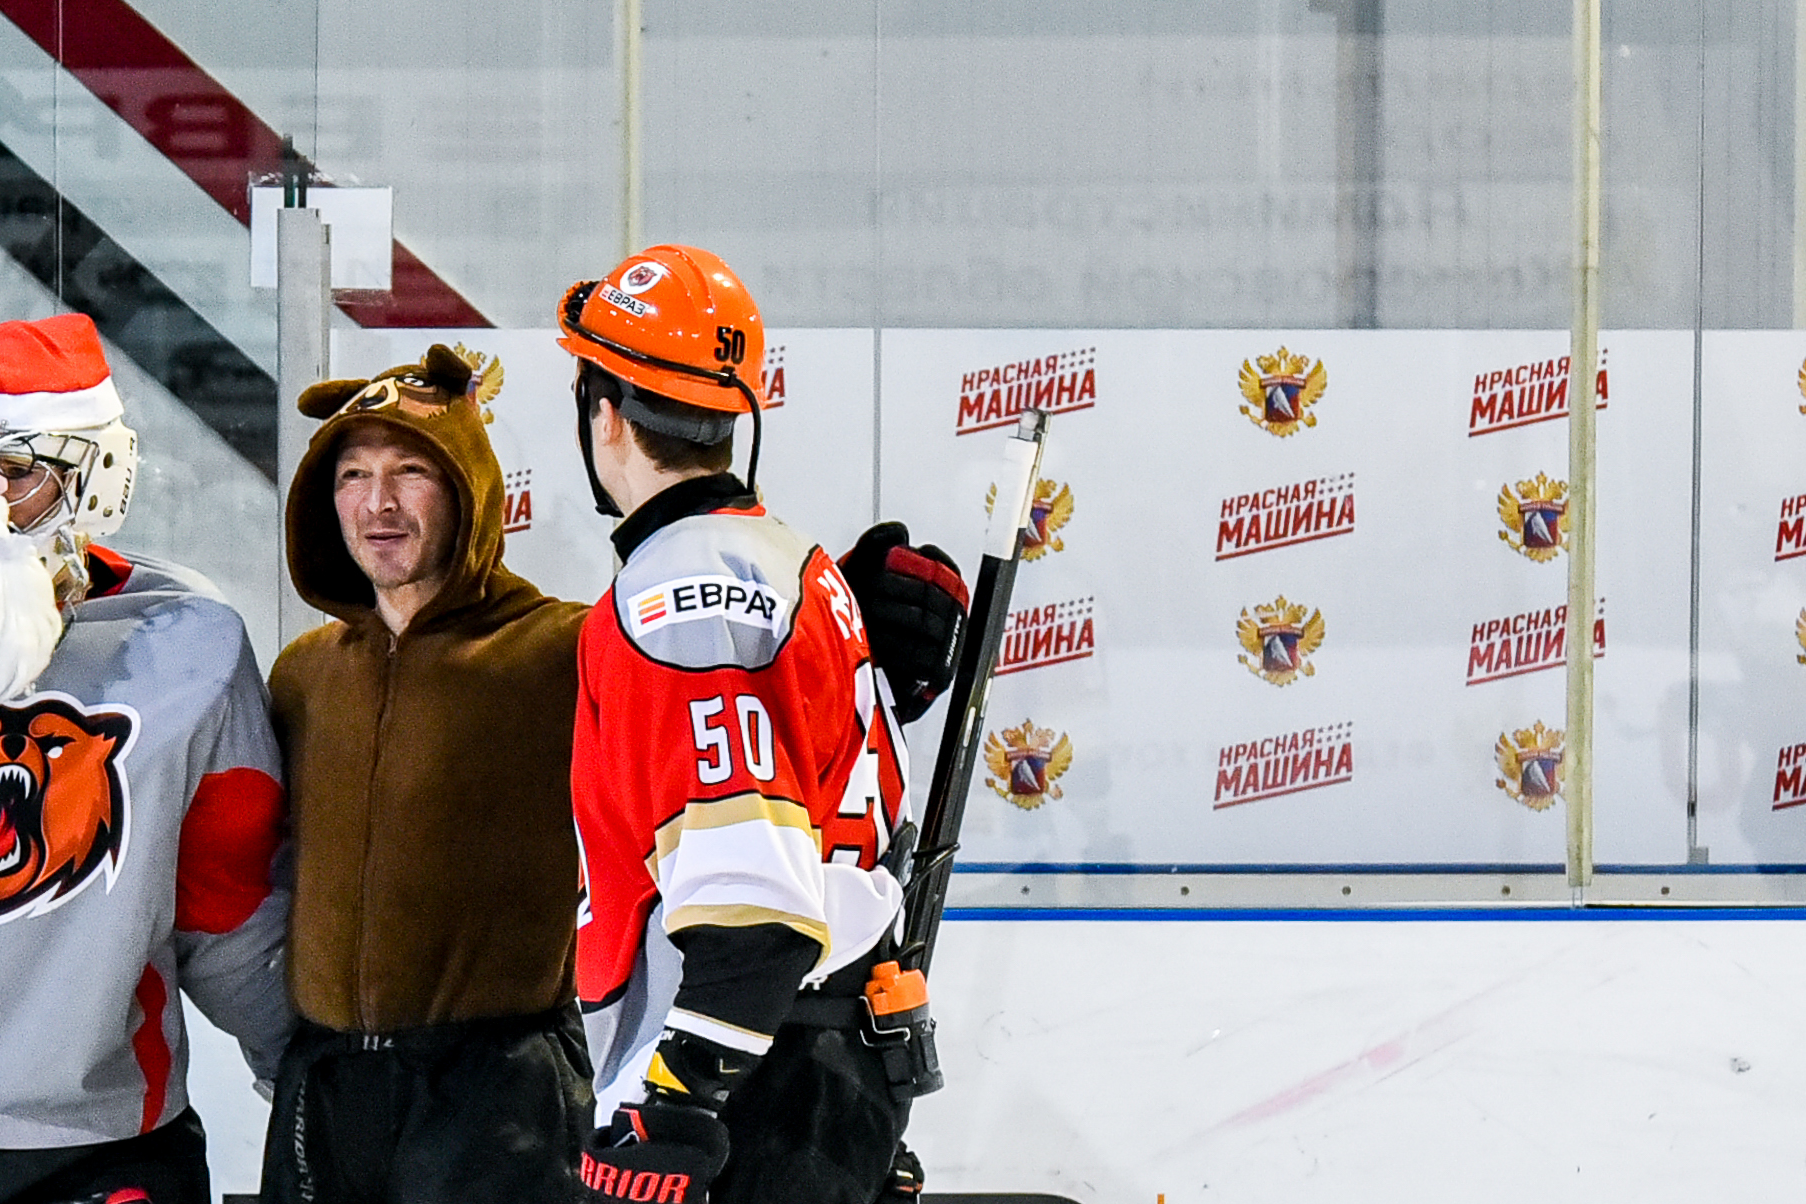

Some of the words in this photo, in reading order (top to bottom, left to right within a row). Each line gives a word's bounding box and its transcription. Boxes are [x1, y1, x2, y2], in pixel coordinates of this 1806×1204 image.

[609, 288, 646, 316] ЕВРАЗ
[714, 325, 746, 365] 50
[956, 368, 1096, 428] МАШИНА
[1469, 369, 1608, 429] МАШИА
[1216, 493, 1355, 552] МАШИНА
[1467, 617, 1606, 678] МАШИА
[689, 694, 776, 785] 50
[1214, 741, 1352, 802] МАШИНА
